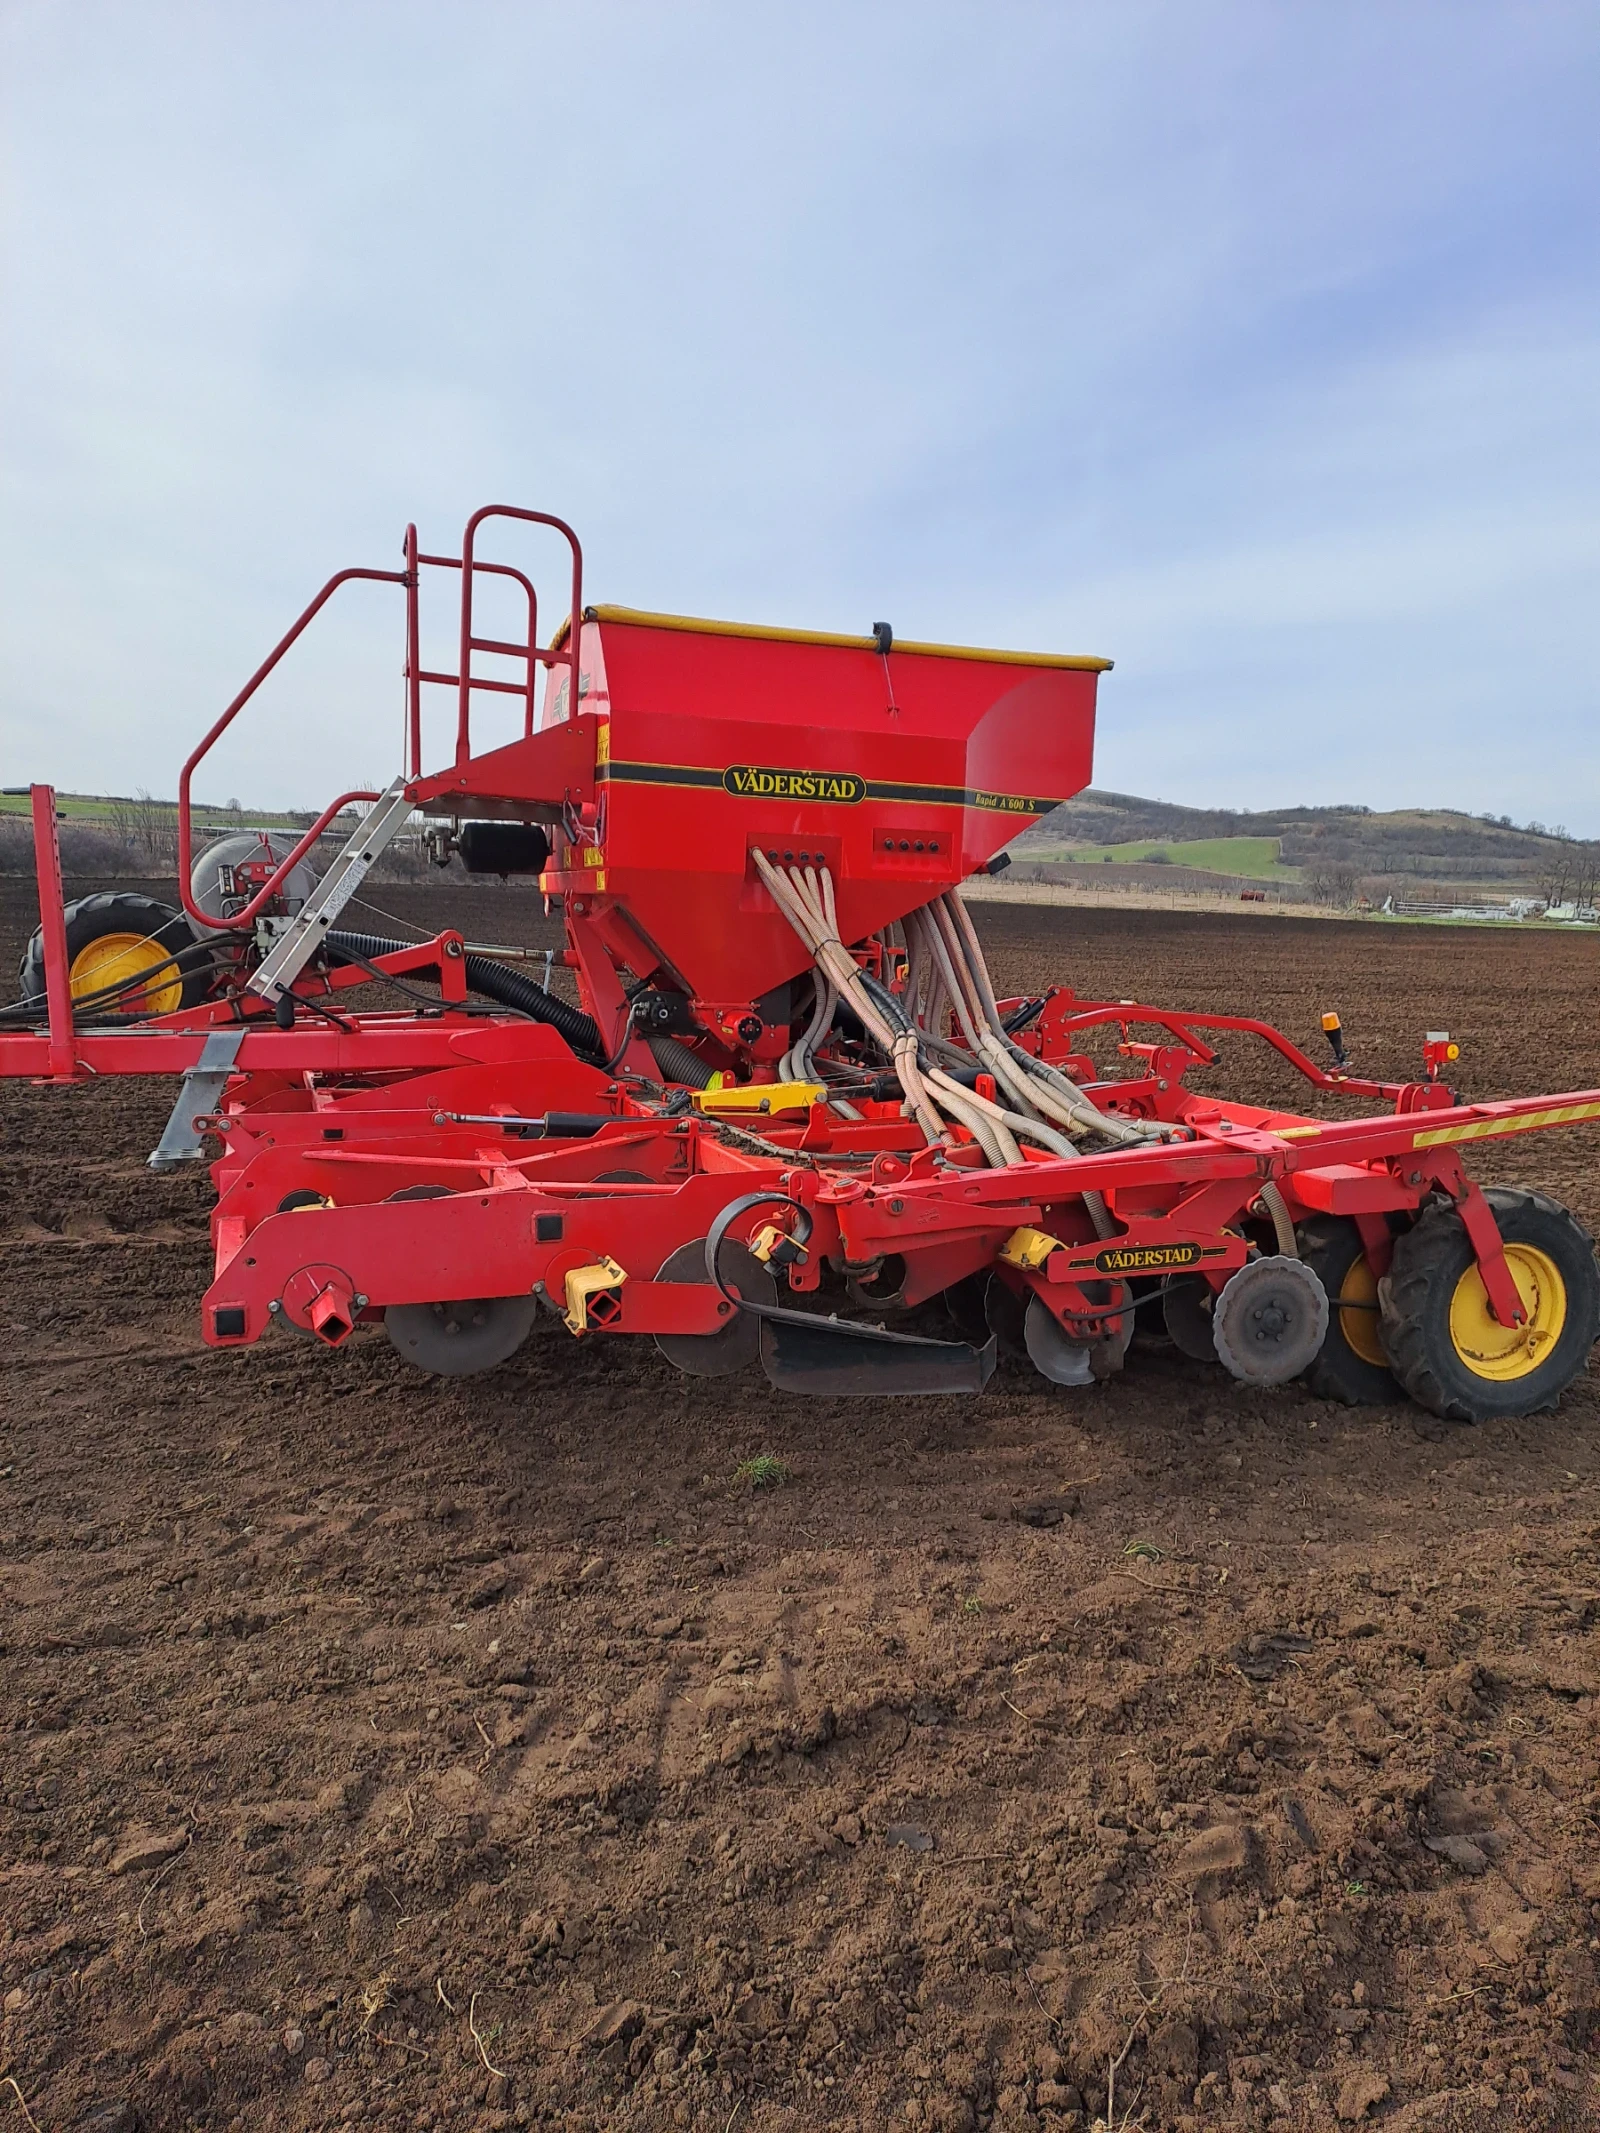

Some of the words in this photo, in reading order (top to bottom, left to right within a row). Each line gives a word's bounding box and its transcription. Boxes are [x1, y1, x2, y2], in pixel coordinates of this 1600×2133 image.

[733, 768, 856, 798] VÄDERSTAD
[975, 794, 997, 807] Rapid
[1000, 798, 1006, 808] A
[1008, 798, 1024, 810] 600
[1028, 800, 1035, 811] S
[1104, 1248, 1192, 1268] VÄDERSTAD
